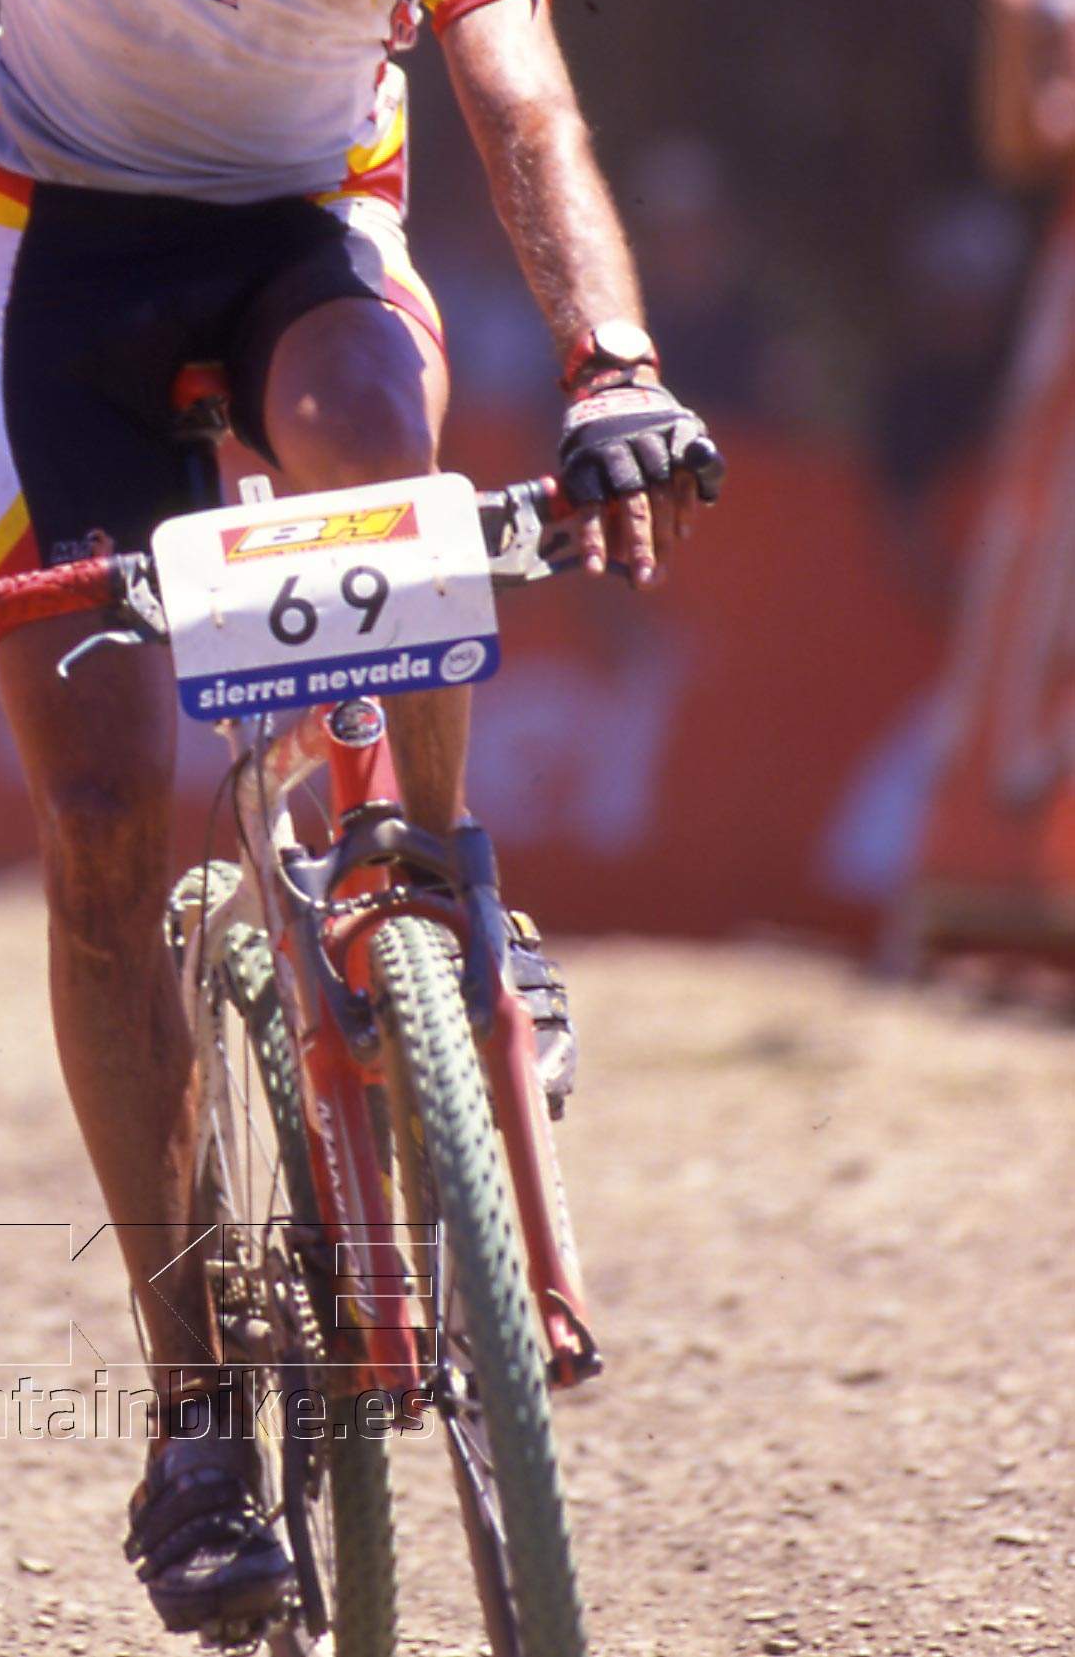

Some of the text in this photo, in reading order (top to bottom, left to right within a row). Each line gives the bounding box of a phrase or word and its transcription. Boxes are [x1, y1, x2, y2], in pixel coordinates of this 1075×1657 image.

[233, 505, 405, 554] BH
[268, 565, 390, 646] 69
[199, 676, 297, 710] sierra
[307, 653, 431, 694] nevada
